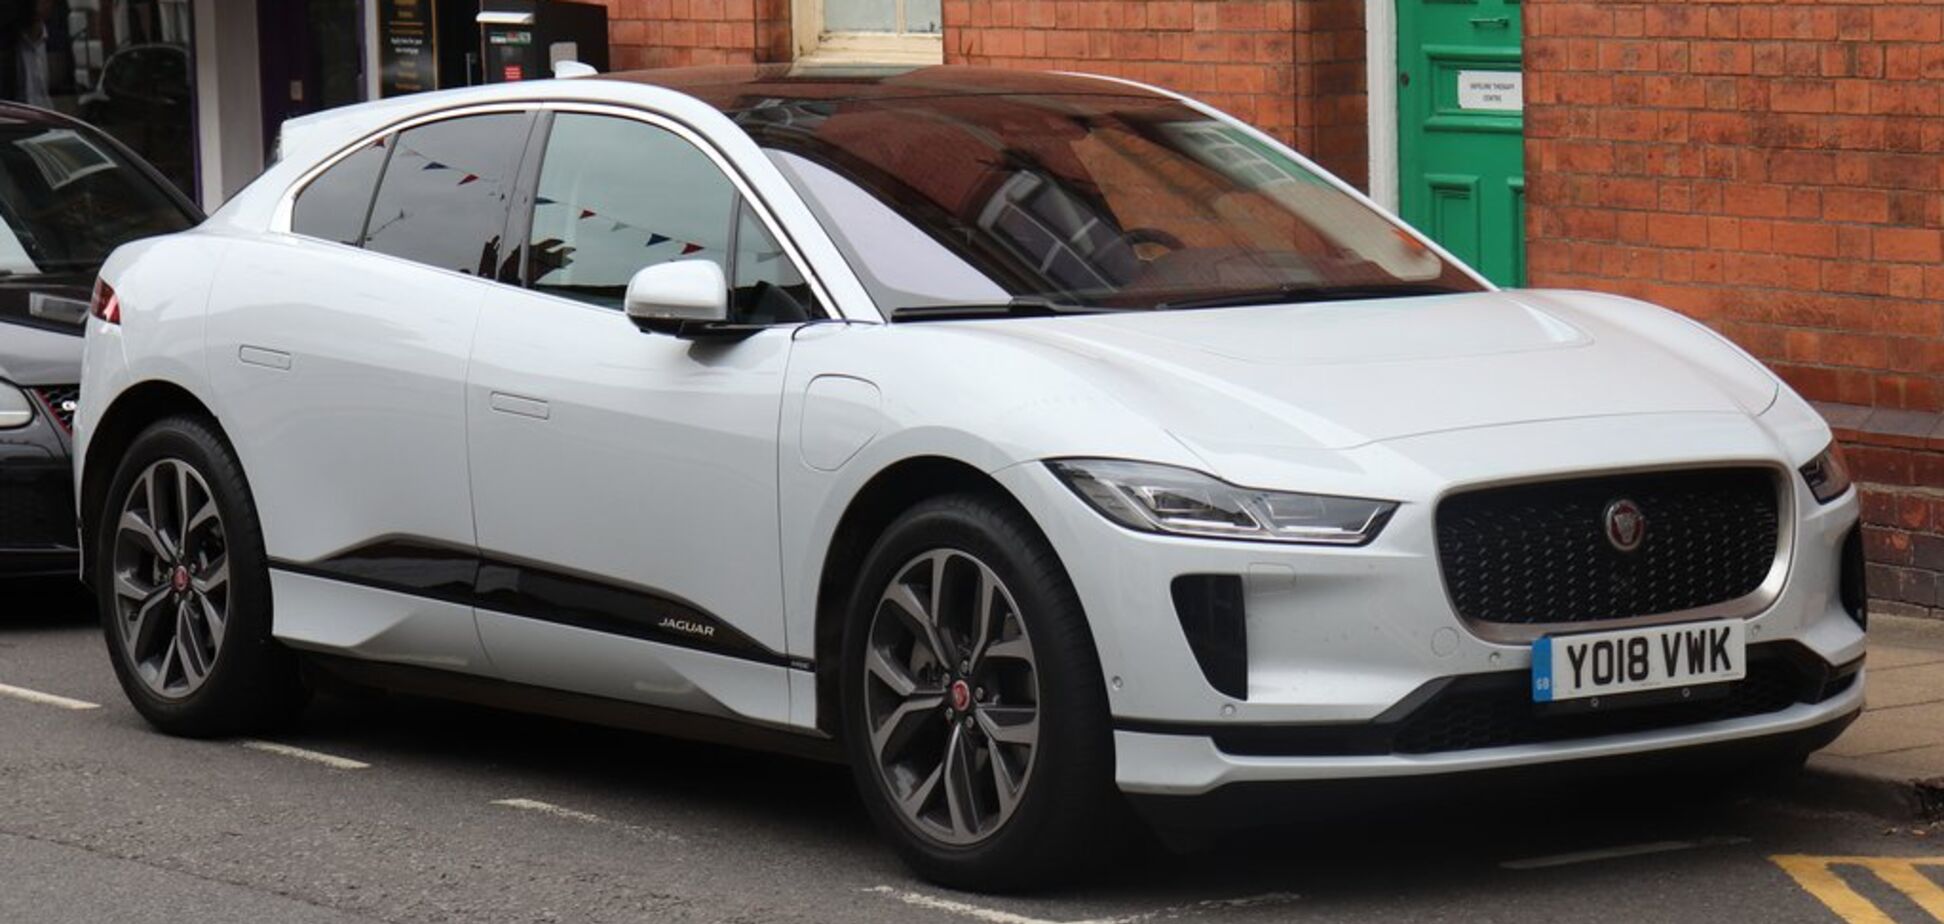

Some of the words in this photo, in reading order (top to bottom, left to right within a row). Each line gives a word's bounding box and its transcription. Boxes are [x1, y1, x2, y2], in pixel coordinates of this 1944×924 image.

[658, 618, 715, 636] JAGUAR
[1567, 636, 1649, 689] YO18
[1661, 626, 1732, 678] VWK
[1536, 677, 1550, 690] GB
